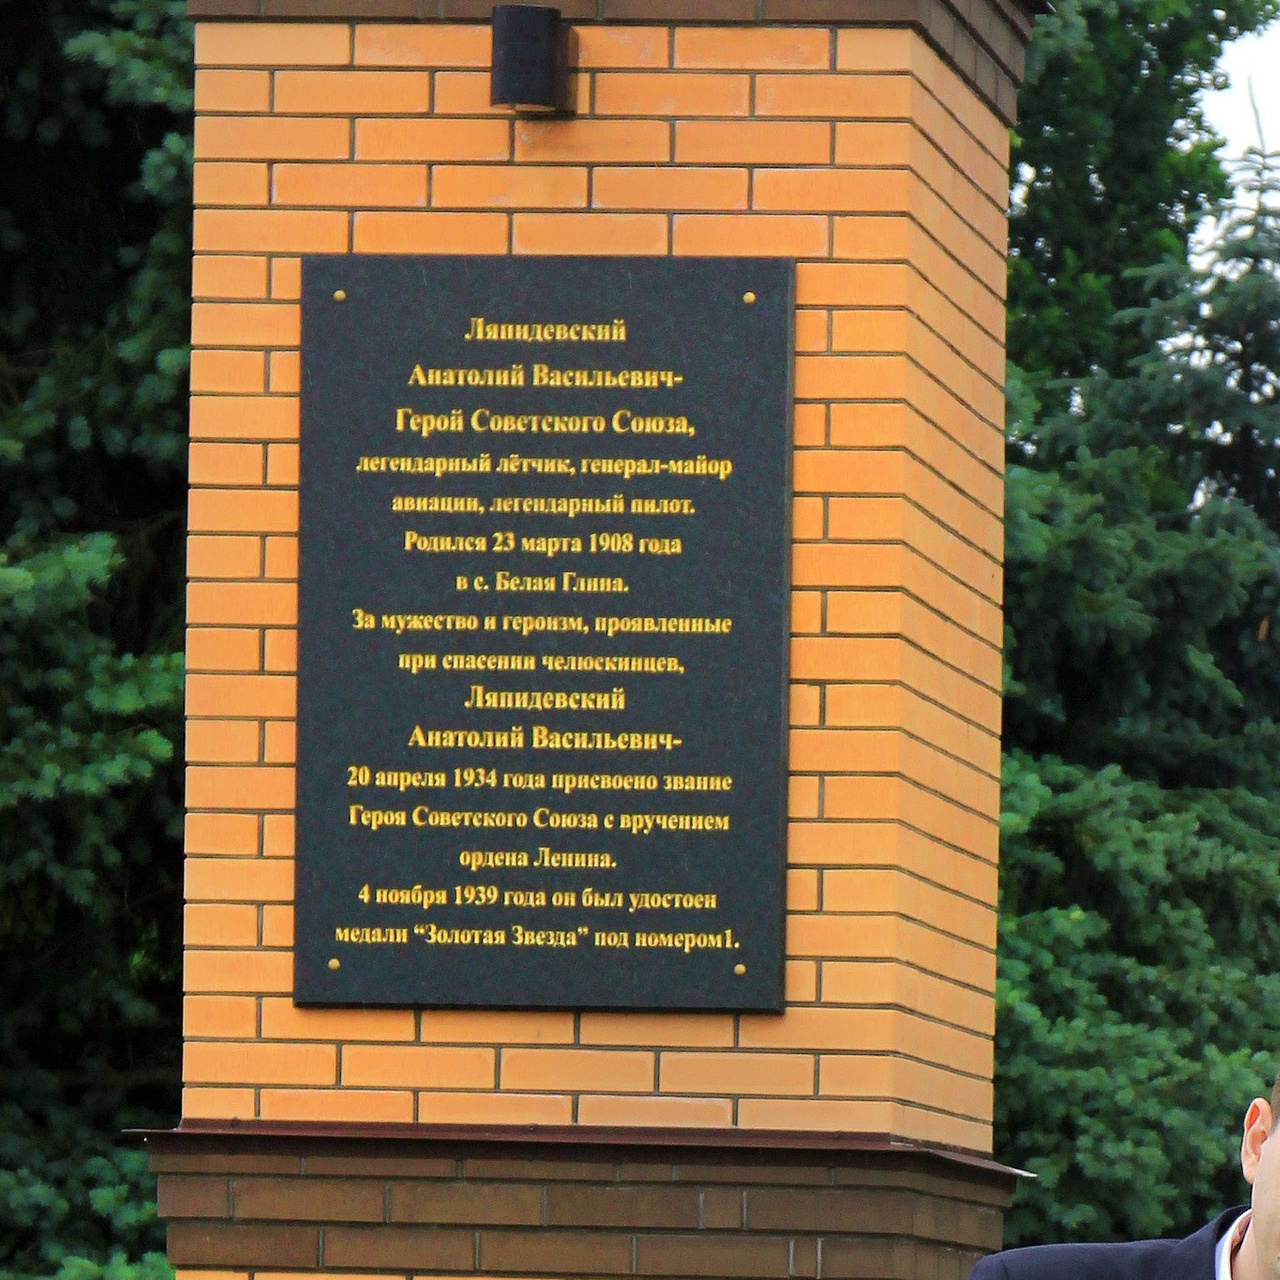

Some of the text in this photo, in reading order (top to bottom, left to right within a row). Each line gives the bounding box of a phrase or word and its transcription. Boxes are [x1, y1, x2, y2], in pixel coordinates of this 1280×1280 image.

[464, 316, 627, 342] Ляпидевский
[409, 362, 683, 388] Анатолий Васильевич-
[396, 406, 696, 439] Герой Советского Союза,
[356, 452, 733, 481] легендарный лётчик, генерал-майор
[391, 493, 696, 518] авиации, легендарный пилот.
[404, 530, 682, 558] Родился 23 марта 1908 года
[456, 570, 629, 593] в с. Белая Глина.
[352, 607, 732, 637] За мужество и героизм, проявленные
[398, 652, 685, 675] при спасении челюскинцев,
[464, 684, 626, 710] Ляпидевский
[408, 724, 682, 751] Анатолий Васильевич-
[347, 765, 733, 794] 20 апреля 1934 года присвоено звание
[349, 803, 730, 835] Героя Советского Союза с вручением
[459, 846, 617, 872] ордена Ленина.
[358, 883, 717, 912] 4 ноября 1939 года он был удостоен
[335, 926, 408, 944] медали
[413, 922, 506, 945] “Золотая
[511, 924, 589, 947] Звезда”
[594, 931, 629, 948] под
